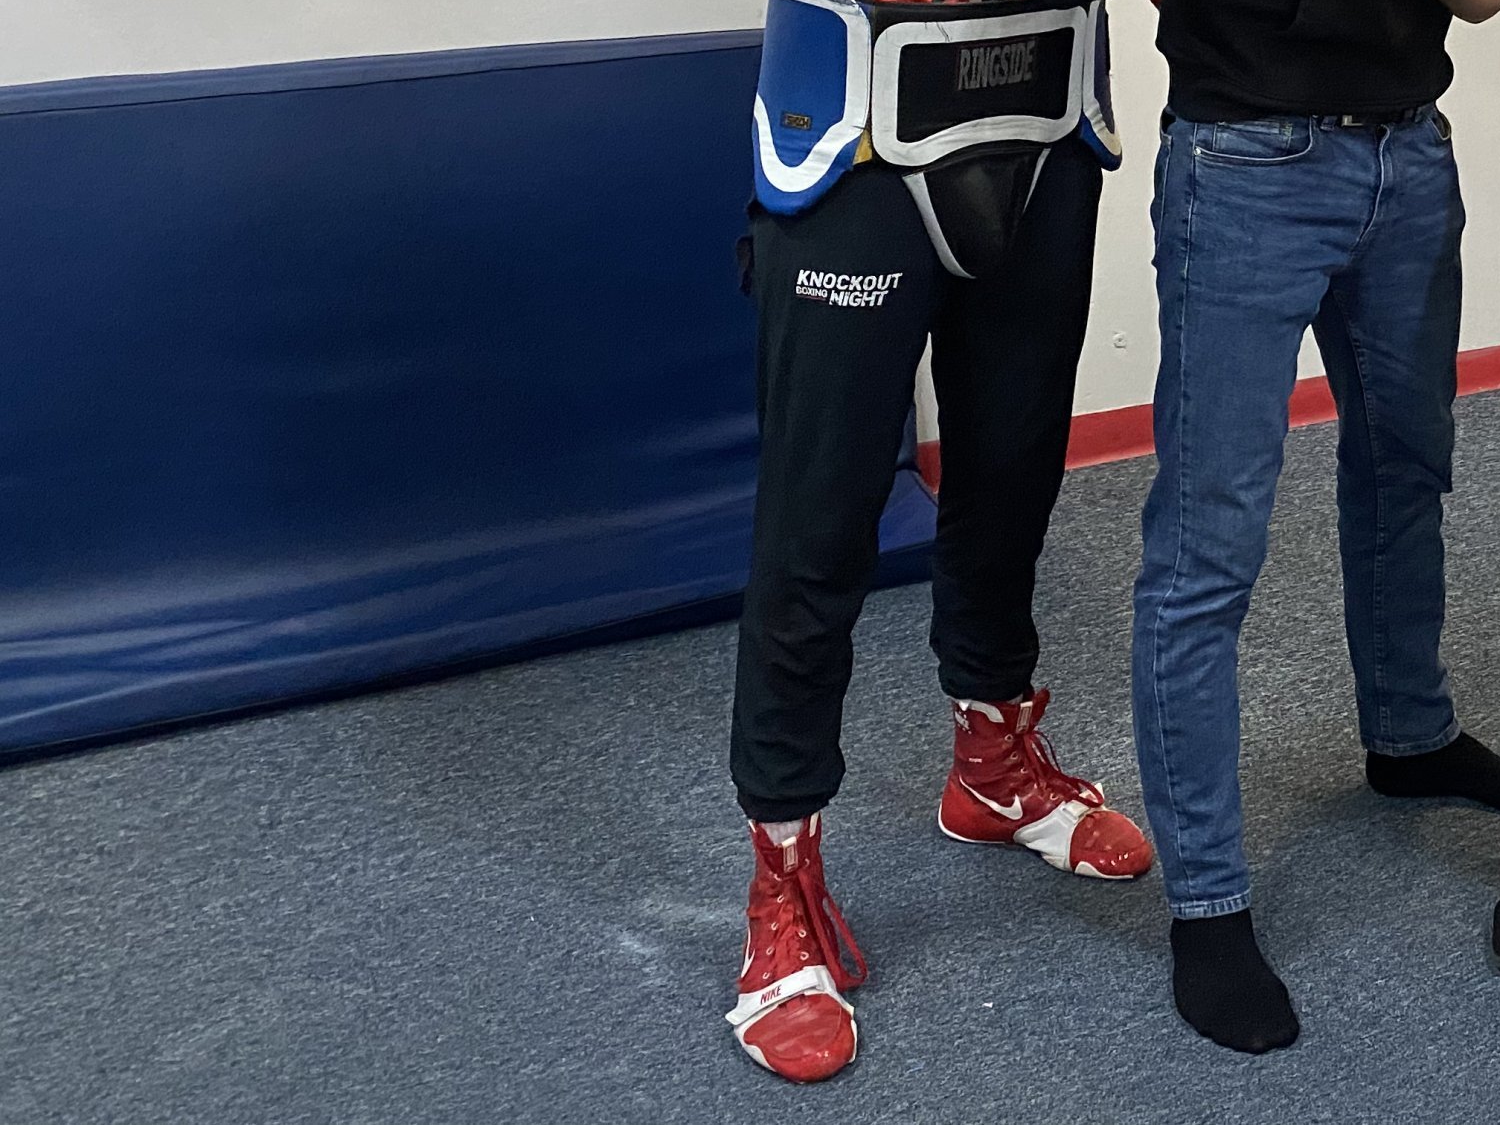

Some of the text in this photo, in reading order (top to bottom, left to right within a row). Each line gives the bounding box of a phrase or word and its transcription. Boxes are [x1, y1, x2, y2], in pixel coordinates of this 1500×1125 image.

[958, 40, 1036, 90] RINGSIDE
[797, 269, 903, 291] KNOCKOUT
[796, 286, 888, 307] BOXING NIGHT
[760, 984, 782, 1005] NIKE
